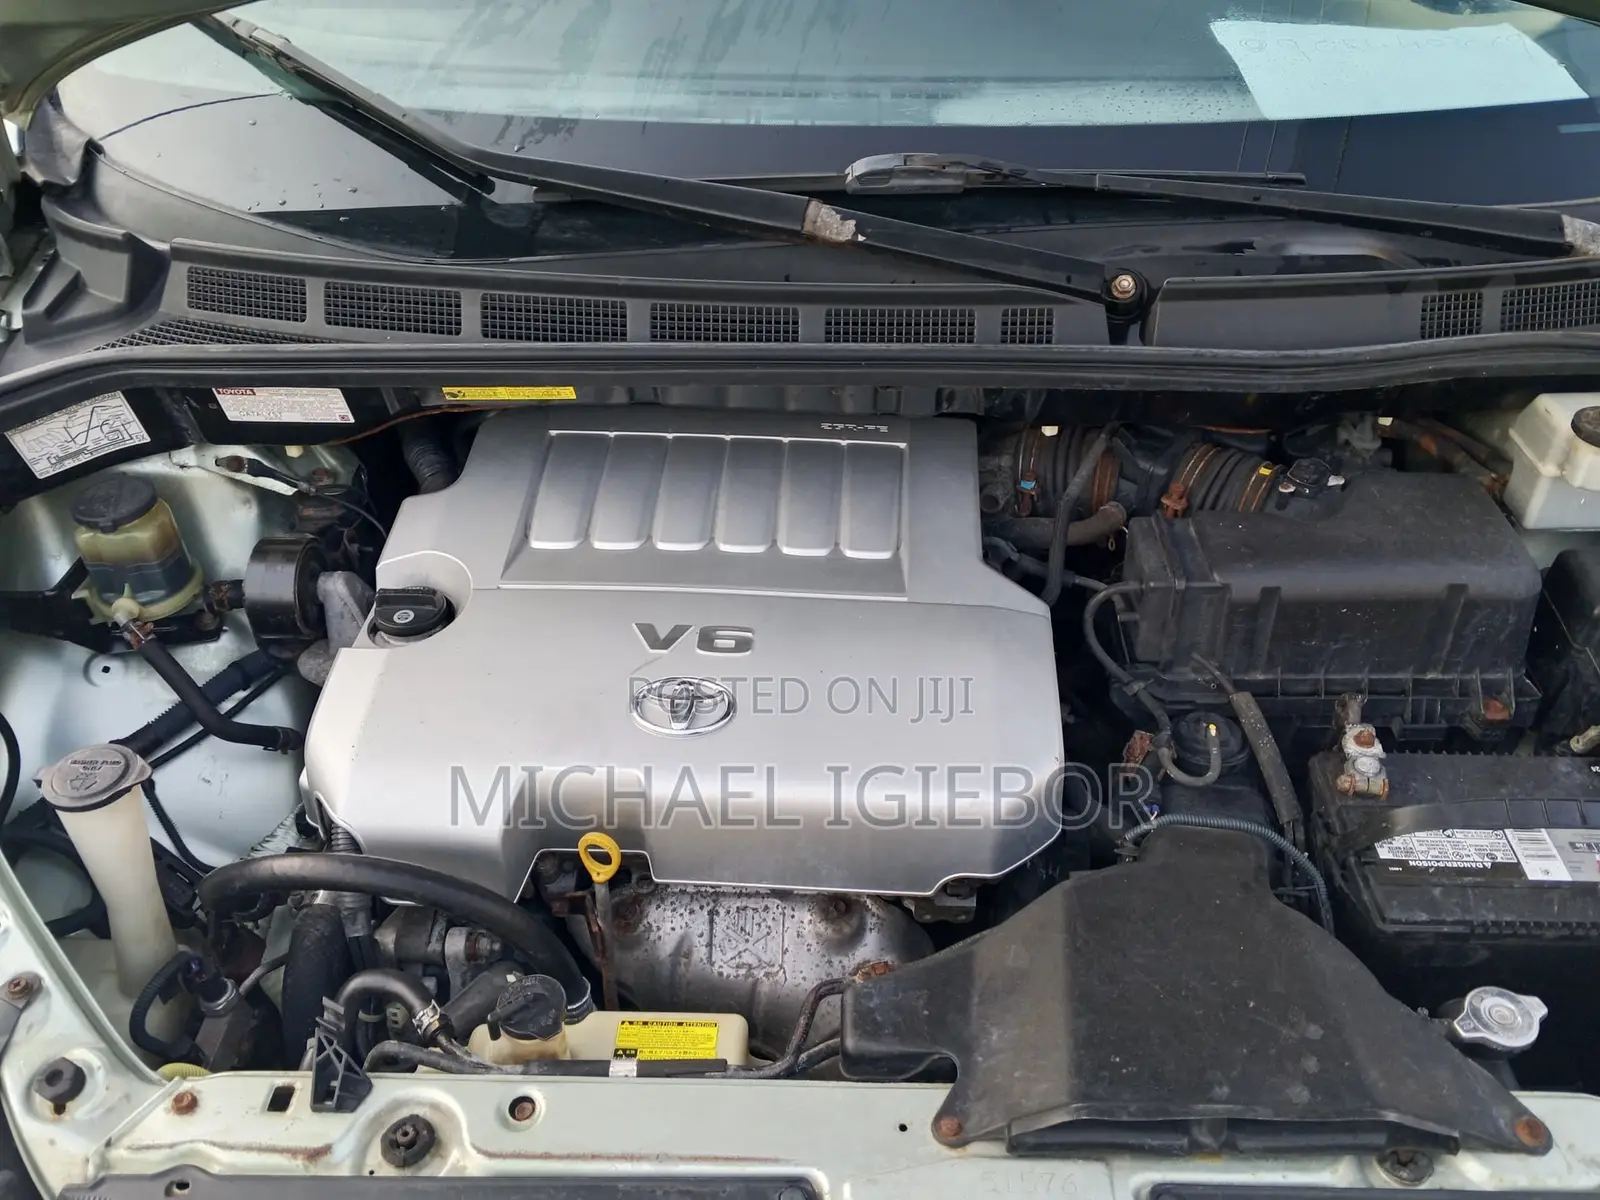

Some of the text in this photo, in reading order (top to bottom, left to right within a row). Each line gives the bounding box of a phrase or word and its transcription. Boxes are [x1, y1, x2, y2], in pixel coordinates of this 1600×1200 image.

[217, 387, 254, 396] TOYOTA
[631, 622, 756, 657] V6
[1408, 860, 1484, 869] DANGER/POISON
